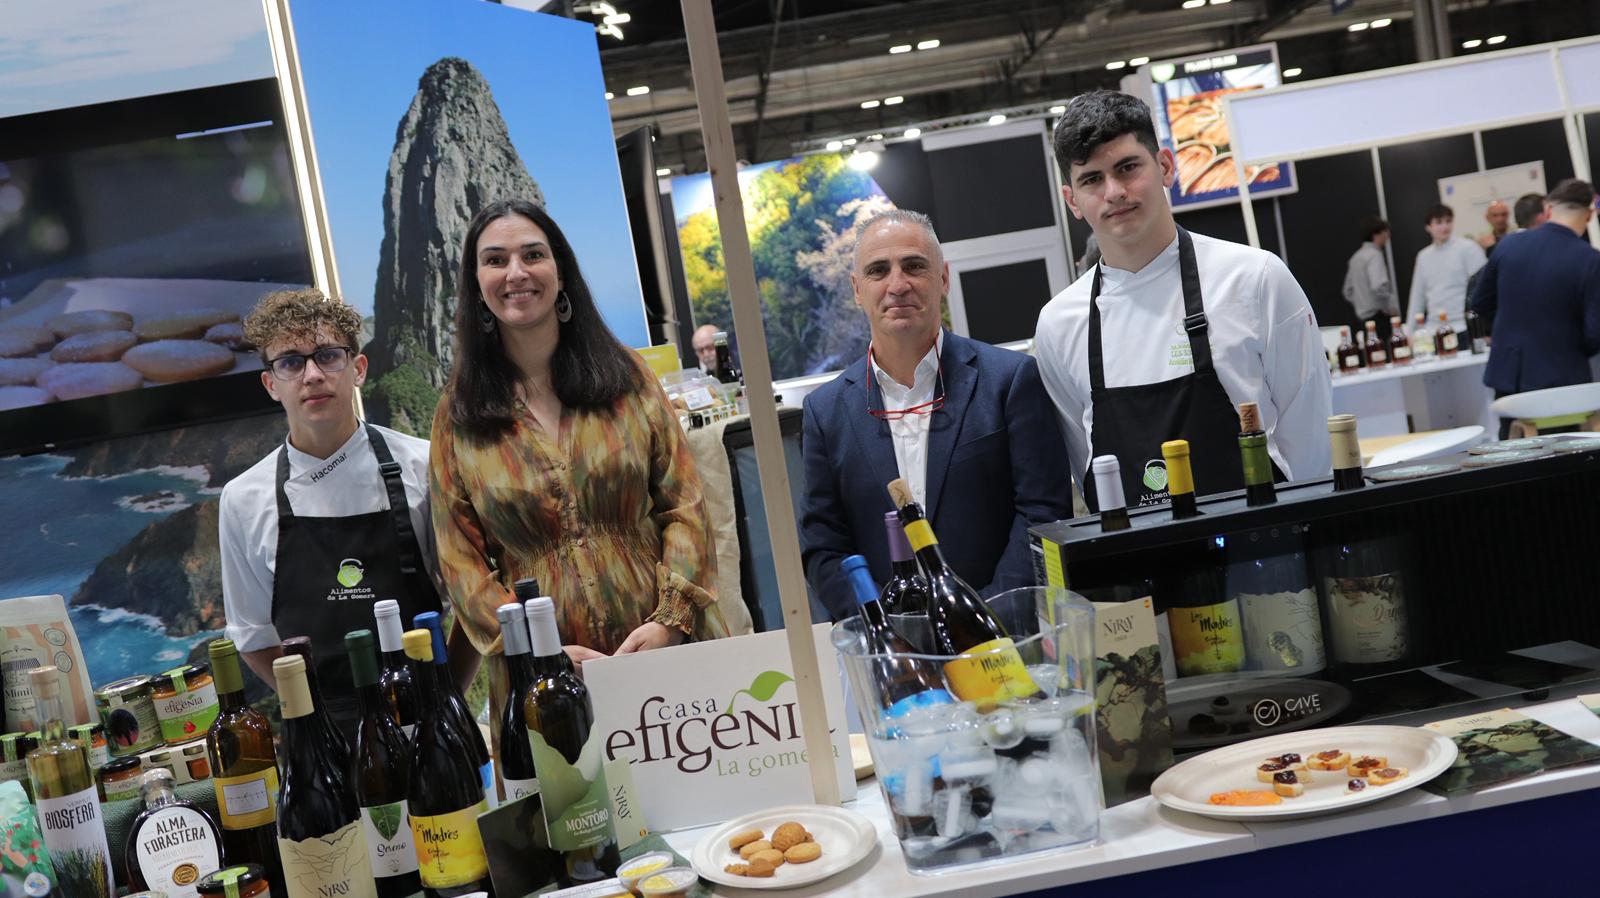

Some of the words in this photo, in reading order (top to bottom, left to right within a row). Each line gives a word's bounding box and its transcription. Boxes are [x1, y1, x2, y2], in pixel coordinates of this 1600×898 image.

[310, 452, 348, 483] Hacomar
[330, 587, 372, 595] Alimentos
[350, 592, 376, 600] Gomera
[658, 697, 719, 720] casa
[1285, 694, 1320, 711] CAVE
[716, 758, 740, 777] La
[747, 744, 840, 777] gomea
[45, 802, 95, 830] BIOSFERA
[156, 815, 187, 835] ALMA
[566, 807, 609, 832] MONTORO
[144, 826, 206, 855] FORASTERA
[422, 826, 459, 843] Madres
